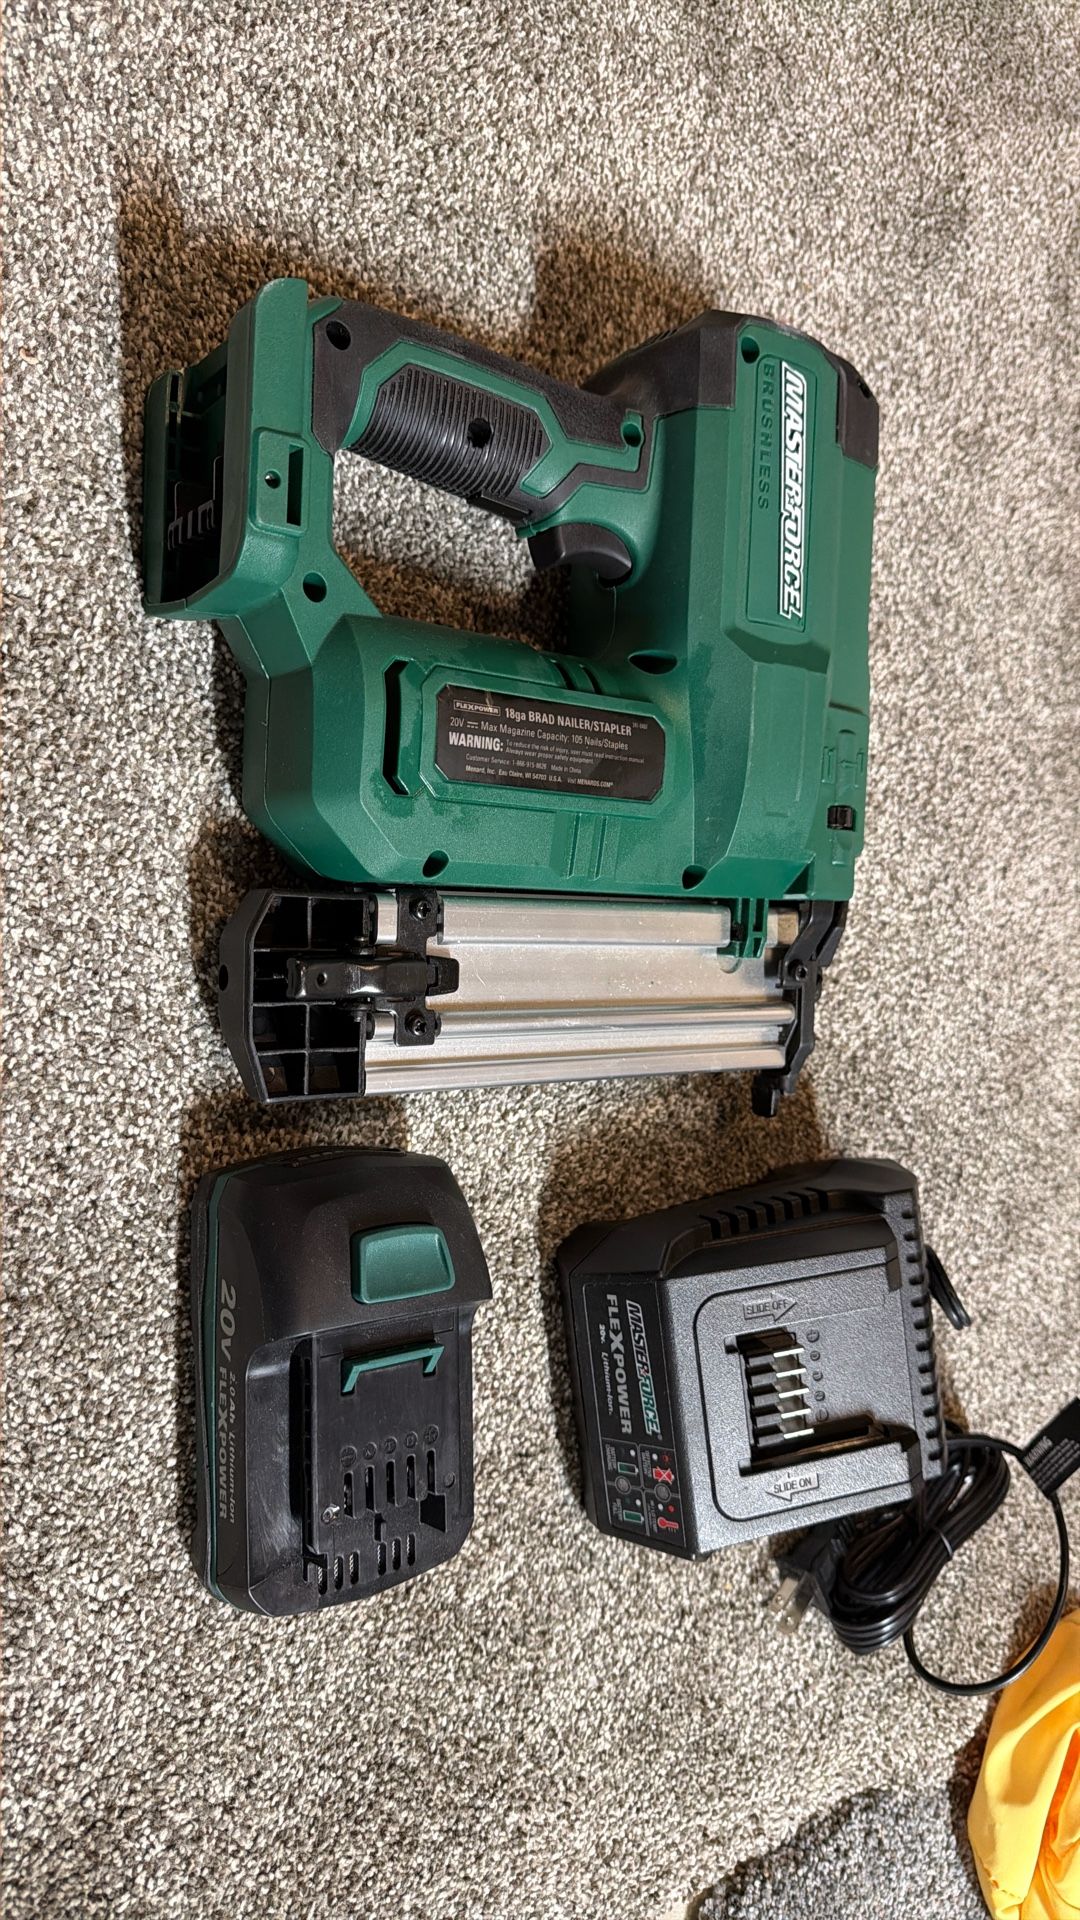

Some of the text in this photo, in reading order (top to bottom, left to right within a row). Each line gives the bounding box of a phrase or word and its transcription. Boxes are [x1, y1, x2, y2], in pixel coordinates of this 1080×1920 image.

[758, 363, 775, 510] BRUSHLESS
[780, 360, 806, 619] MASTERFORCE
[455, 701, 499, 714] FLEXPOWER
[505, 707, 526, 722] 18ga
[528, 711, 555, 725] BRAD
[557, 715, 632, 736] NAILER/STAPLER
[448, 731, 504, 752] WARNING:
[450, 716, 629, 751] 20V Max Magazine Capacity: 105 Nails/Staples
[466, 753, 490, 763] Customer
[550, 764, 563, 772] Made
[498, 768, 508, 776] Eau
[746, 1298, 788, 1314] SLIDE OFF
[606, 1293, 632, 1435] FLEXPOWER
[626, 1299, 661, 1436] MASTERFORCE
[218, 1366, 228, 1519] FLEXPOWER
[228, 1371, 237, 1524] 2.0 Ah Lithium-Ion
[773, 1477, 812, 1494] SLIDE ON
